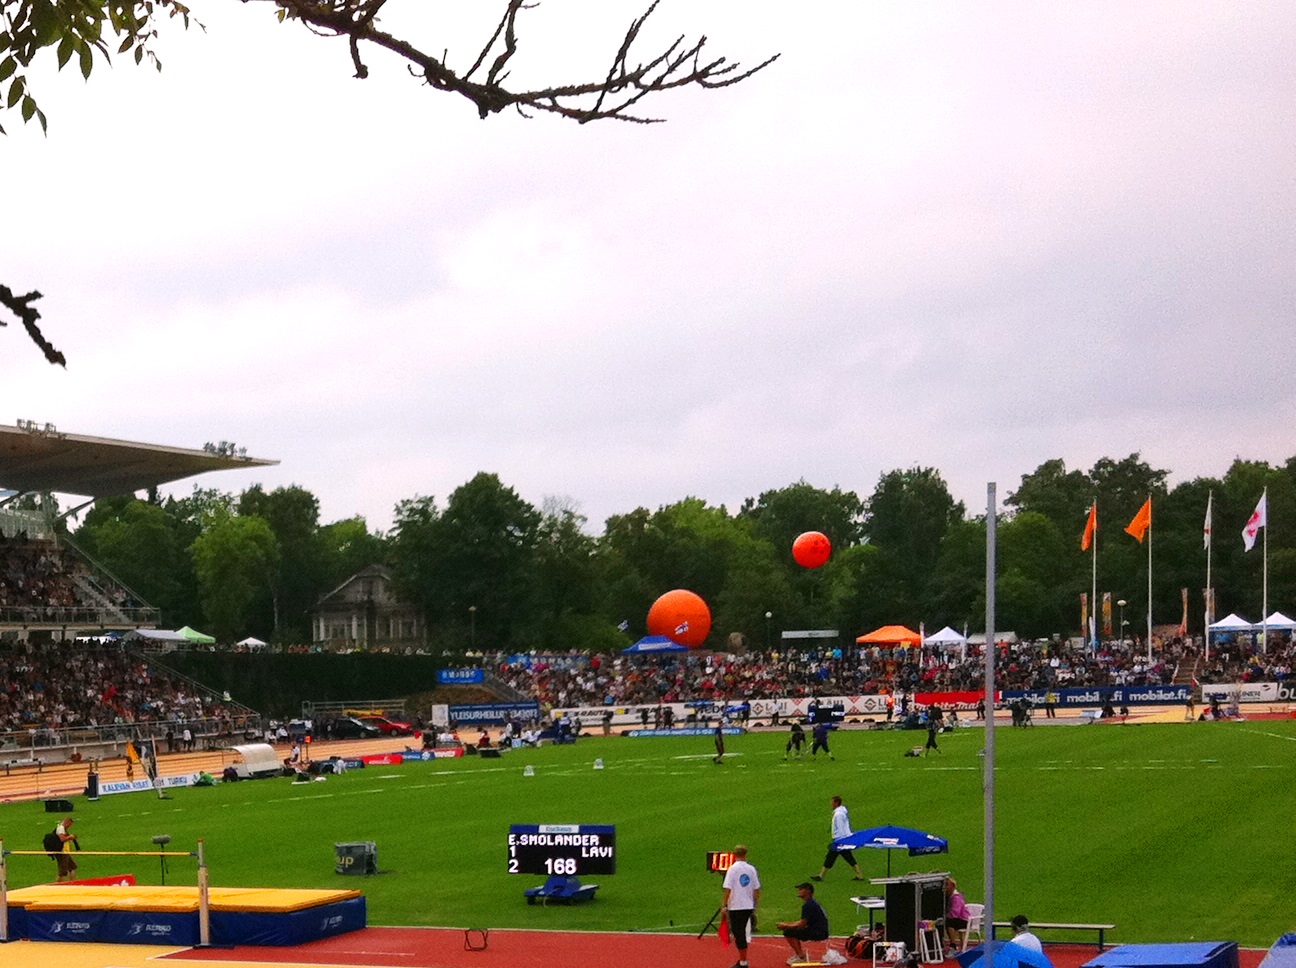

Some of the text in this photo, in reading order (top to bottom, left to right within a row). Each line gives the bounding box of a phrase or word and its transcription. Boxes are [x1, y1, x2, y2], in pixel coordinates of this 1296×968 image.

[581, 846, 614, 858] LAVI
[508, 858, 577, 875] 2 168
